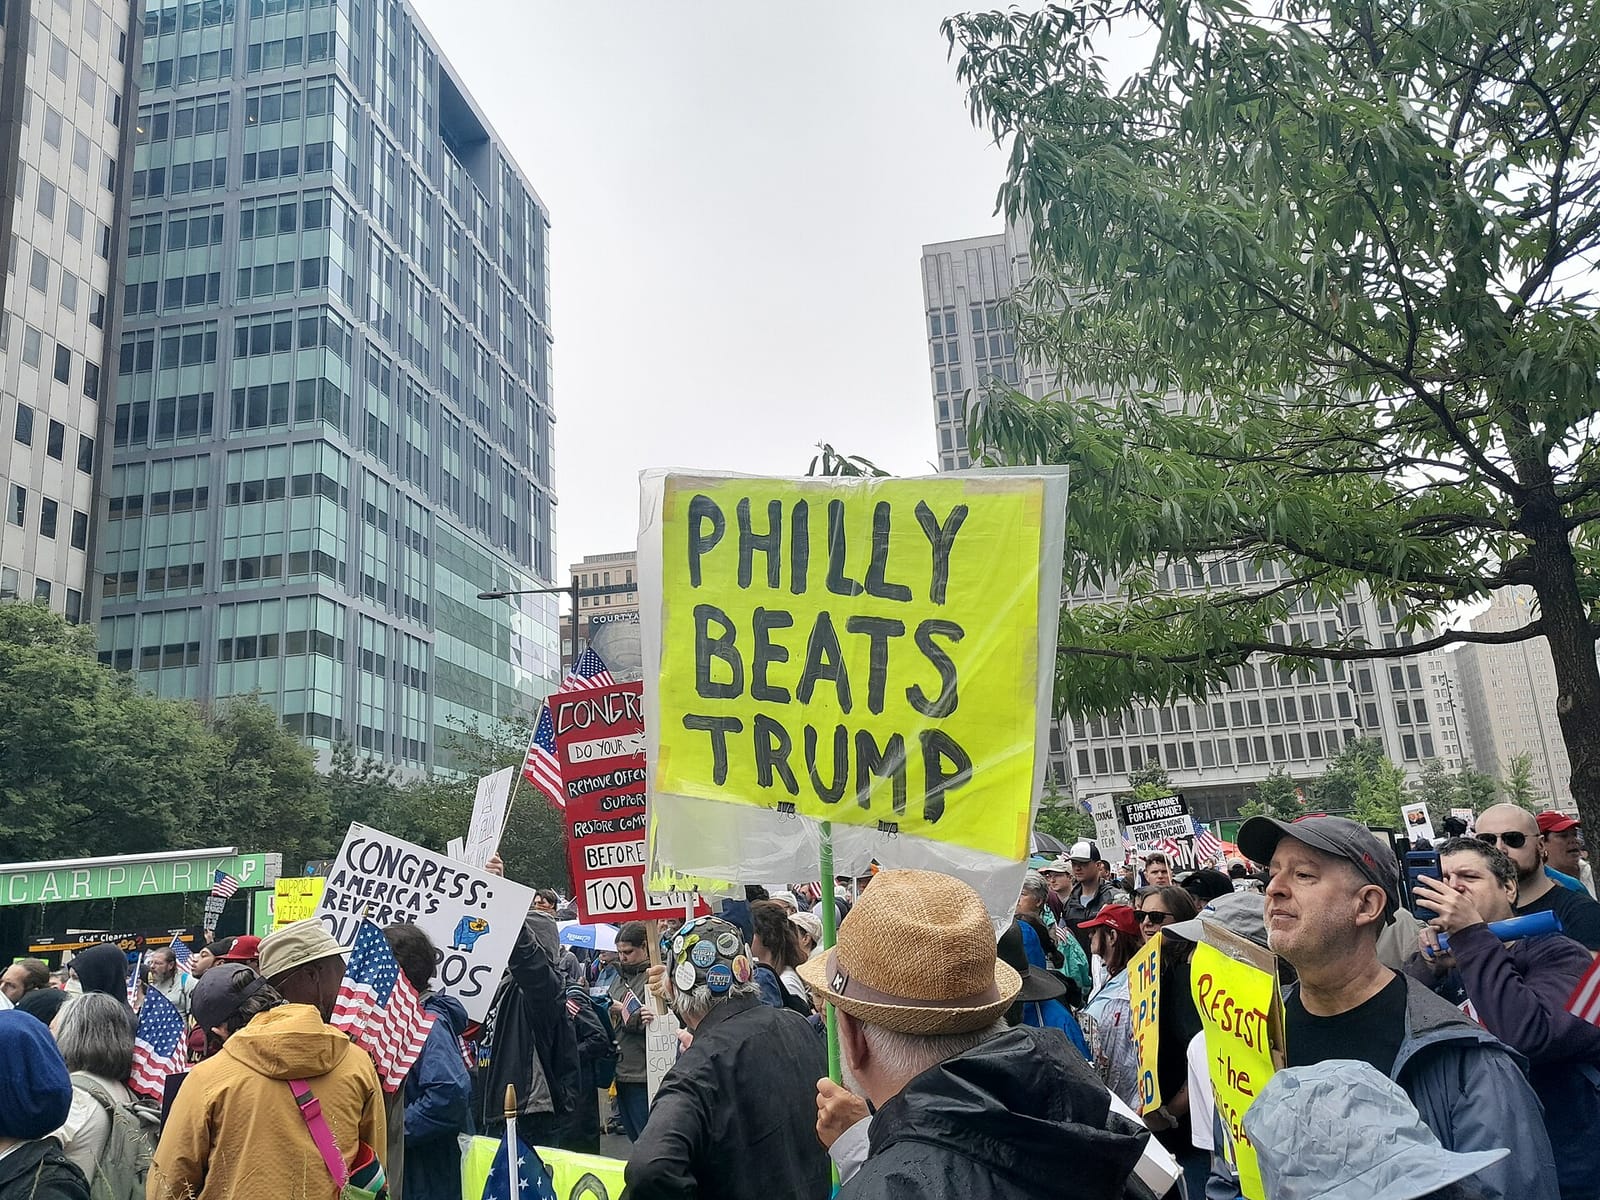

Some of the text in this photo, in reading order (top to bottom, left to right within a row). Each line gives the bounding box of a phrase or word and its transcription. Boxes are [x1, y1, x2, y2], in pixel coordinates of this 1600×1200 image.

[687, 494, 969, 605] PHILLY
[693, 604, 965, 719] BEATS
[575, 739, 626, 759] DO YOUR
[683, 713, 973, 823] TRUMP
[1128, 805, 1182, 823] FOR A PARADE?
[1133, 801, 1158, 812] THERE'S
[1158, 796, 1179, 807] MONEY
[1132, 817, 1185, 833] THEN THERE'S MONEY
[1135, 824, 1187, 842] FOR MEDICAID!
[346, 838, 493, 909] CONGRESS:
[587, 842, 645, 868] BEFORE
[278, 879, 314, 893] SUPPORT
[331, 870, 440, 914] AMERICA'S
[587, 880, 633, 911] TOO
[321, 887, 418, 925] REVERSE
[1138, 950, 1156, 992] THE
[1197, 973, 1268, 1054] RESIST
[1217, 1048, 1254, 1097] the
